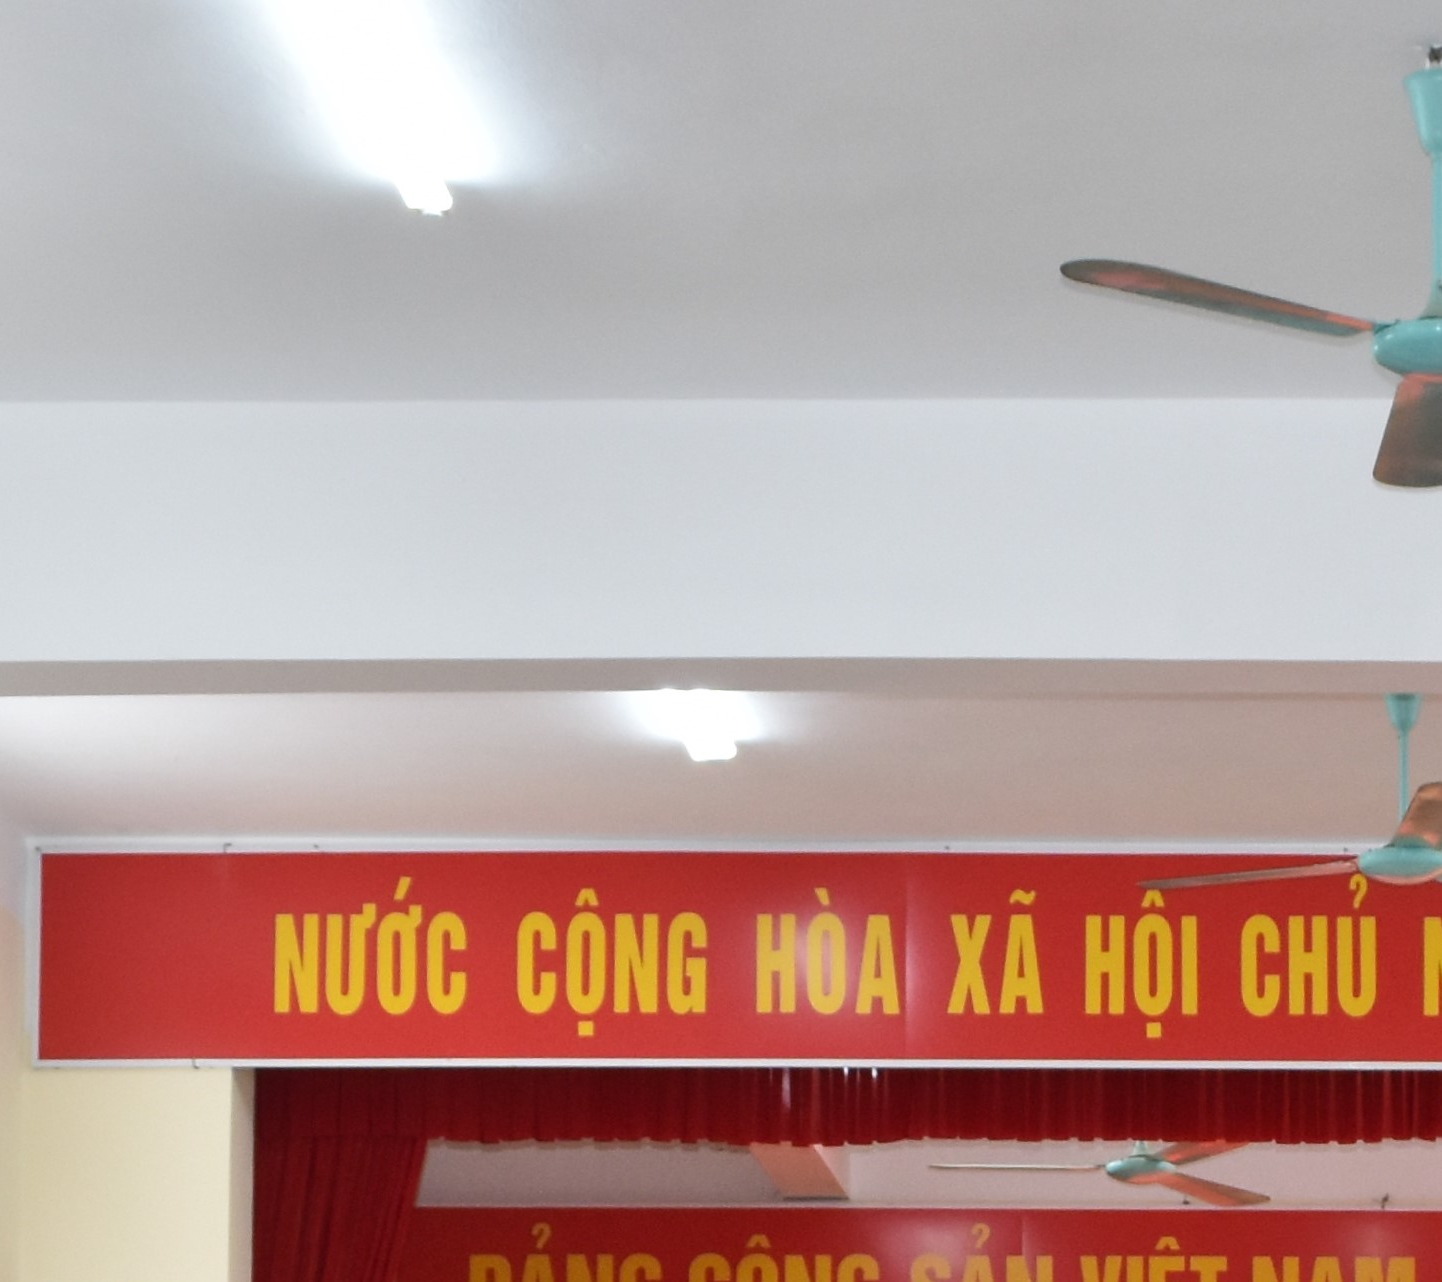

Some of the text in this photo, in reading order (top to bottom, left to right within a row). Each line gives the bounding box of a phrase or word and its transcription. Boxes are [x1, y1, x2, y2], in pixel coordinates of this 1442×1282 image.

[274, 876, 468, 1017] NƯỚC
[516, 888, 708, 1038] CỘNG
[757, 888, 900, 1016] HÒA
[948, 889, 1044, 1016] XÃ
[1085, 889, 1199, 1040] HỘI
[1240, 873, 1377, 1018] CHỦ
